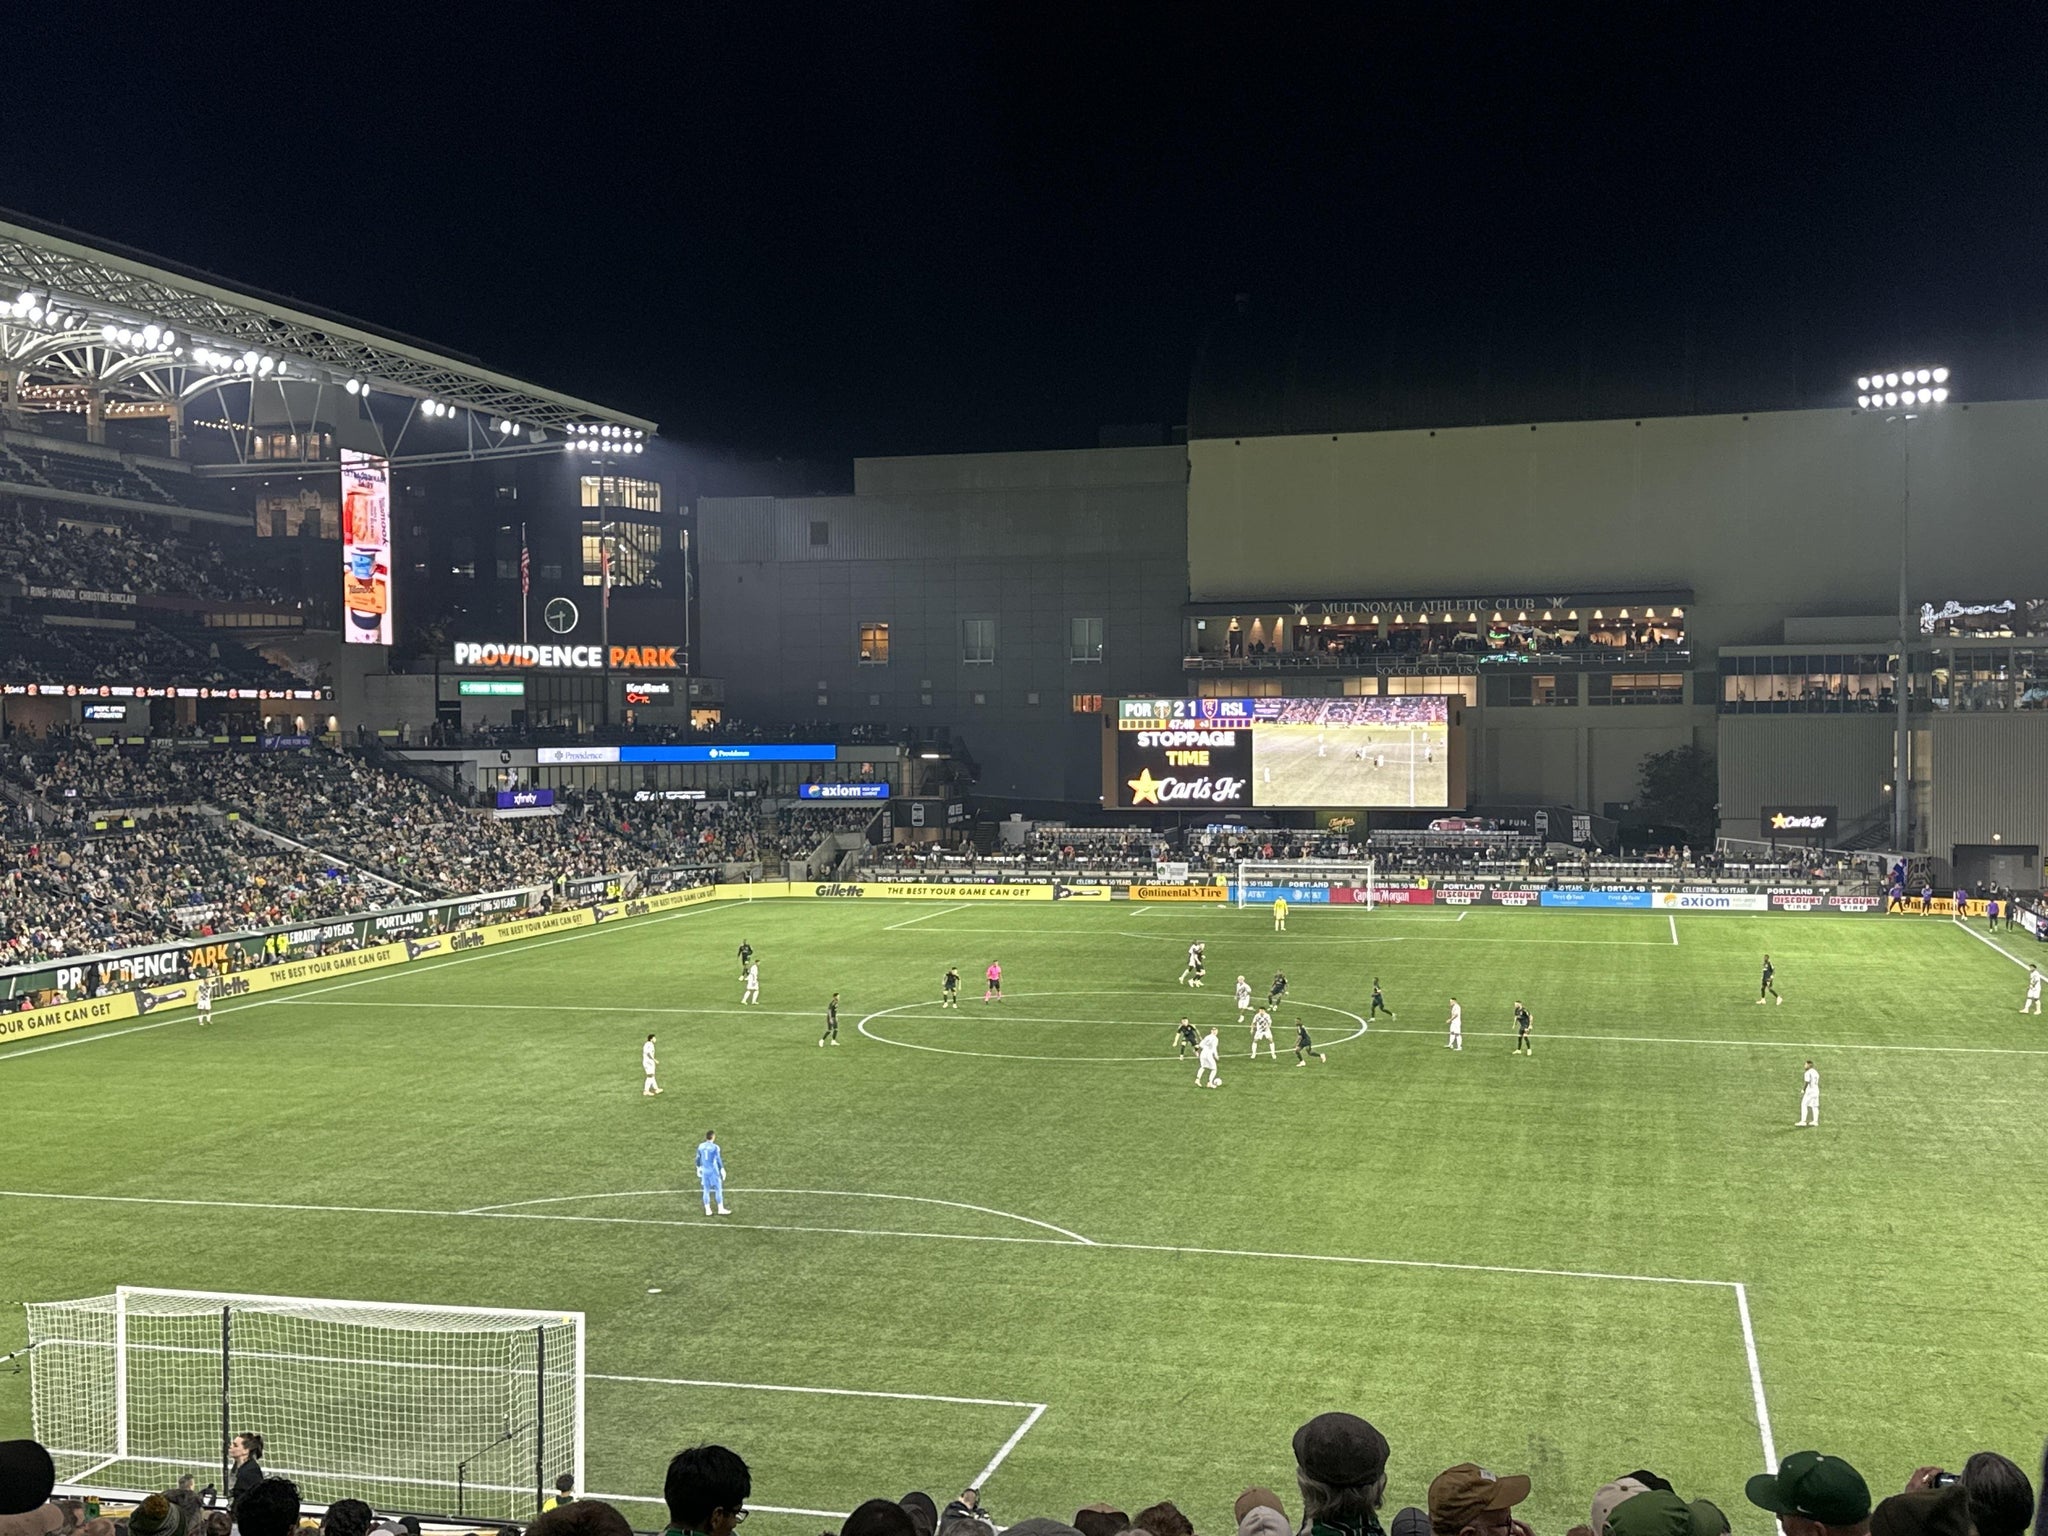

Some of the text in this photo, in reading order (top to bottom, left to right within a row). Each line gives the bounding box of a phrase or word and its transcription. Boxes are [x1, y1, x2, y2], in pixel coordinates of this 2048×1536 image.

[30, 586, 47, 598] RING
[52, 589, 76, 600] HONOR
[1321, 598, 1536, 614] MULTNOMAH ATHLETIC CLUB
[454, 642, 677, 668] PROVIDENCE PARK
[1376, 664, 1482, 677] SOCCER CITY USA
[626, 683, 670, 694] KeyBank
[1125, 701, 1247, 717] POR 2 1 RSL
[1137, 732, 1235, 747] STOPPAGE
[565, 752, 603, 760] Providence
[719, 750, 750, 758] Providence
[1165, 750, 1210, 766] TIME
[822, 784, 861, 797] axiom
[1156, 776, 1241, 801] Carl's Jr.
[514, 793, 537, 806] xfinity
[1572, 820, 1590, 830] PUB
[570, 881, 605, 896] PRTLAND
[815, 884, 864, 897] Gillette
[888, 887, 903, 895] THE
[907, 887, 927, 895] BEST
[930, 887, 955, 896] YOUR
[959, 888, 986, 896] GAME
[1138, 887, 1222, 898] Continental Tire
[1443, 883, 1485, 891] PORTLAND
[1767, 888, 1813, 896] PORTLAND
[1248, 891, 1266, 899] AT&T
[1436, 891, 1481, 899] DISCOUNT
[1492, 891, 1538, 899] DISCOUNT
[1681, 895, 1730, 907] axiom
[1773, 896, 1822, 905] DISCOUNT
[1829, 897, 1880, 905] DISCOUNT
[376, 911, 424, 930] PORTLAND
[498, 914, 583, 938] THE BEST YOUR GAME CAN GET
[323, 926, 334, 939] 50
[334, 922, 355, 937] YEARS
[450, 931, 485, 951] Gillette
[270, 949, 391, 983] THE BEST YOUR GAME CAN GET
[214, 977, 250, 997] illette
[0, 1003, 111, 1035] OUR GAME CAN GET
